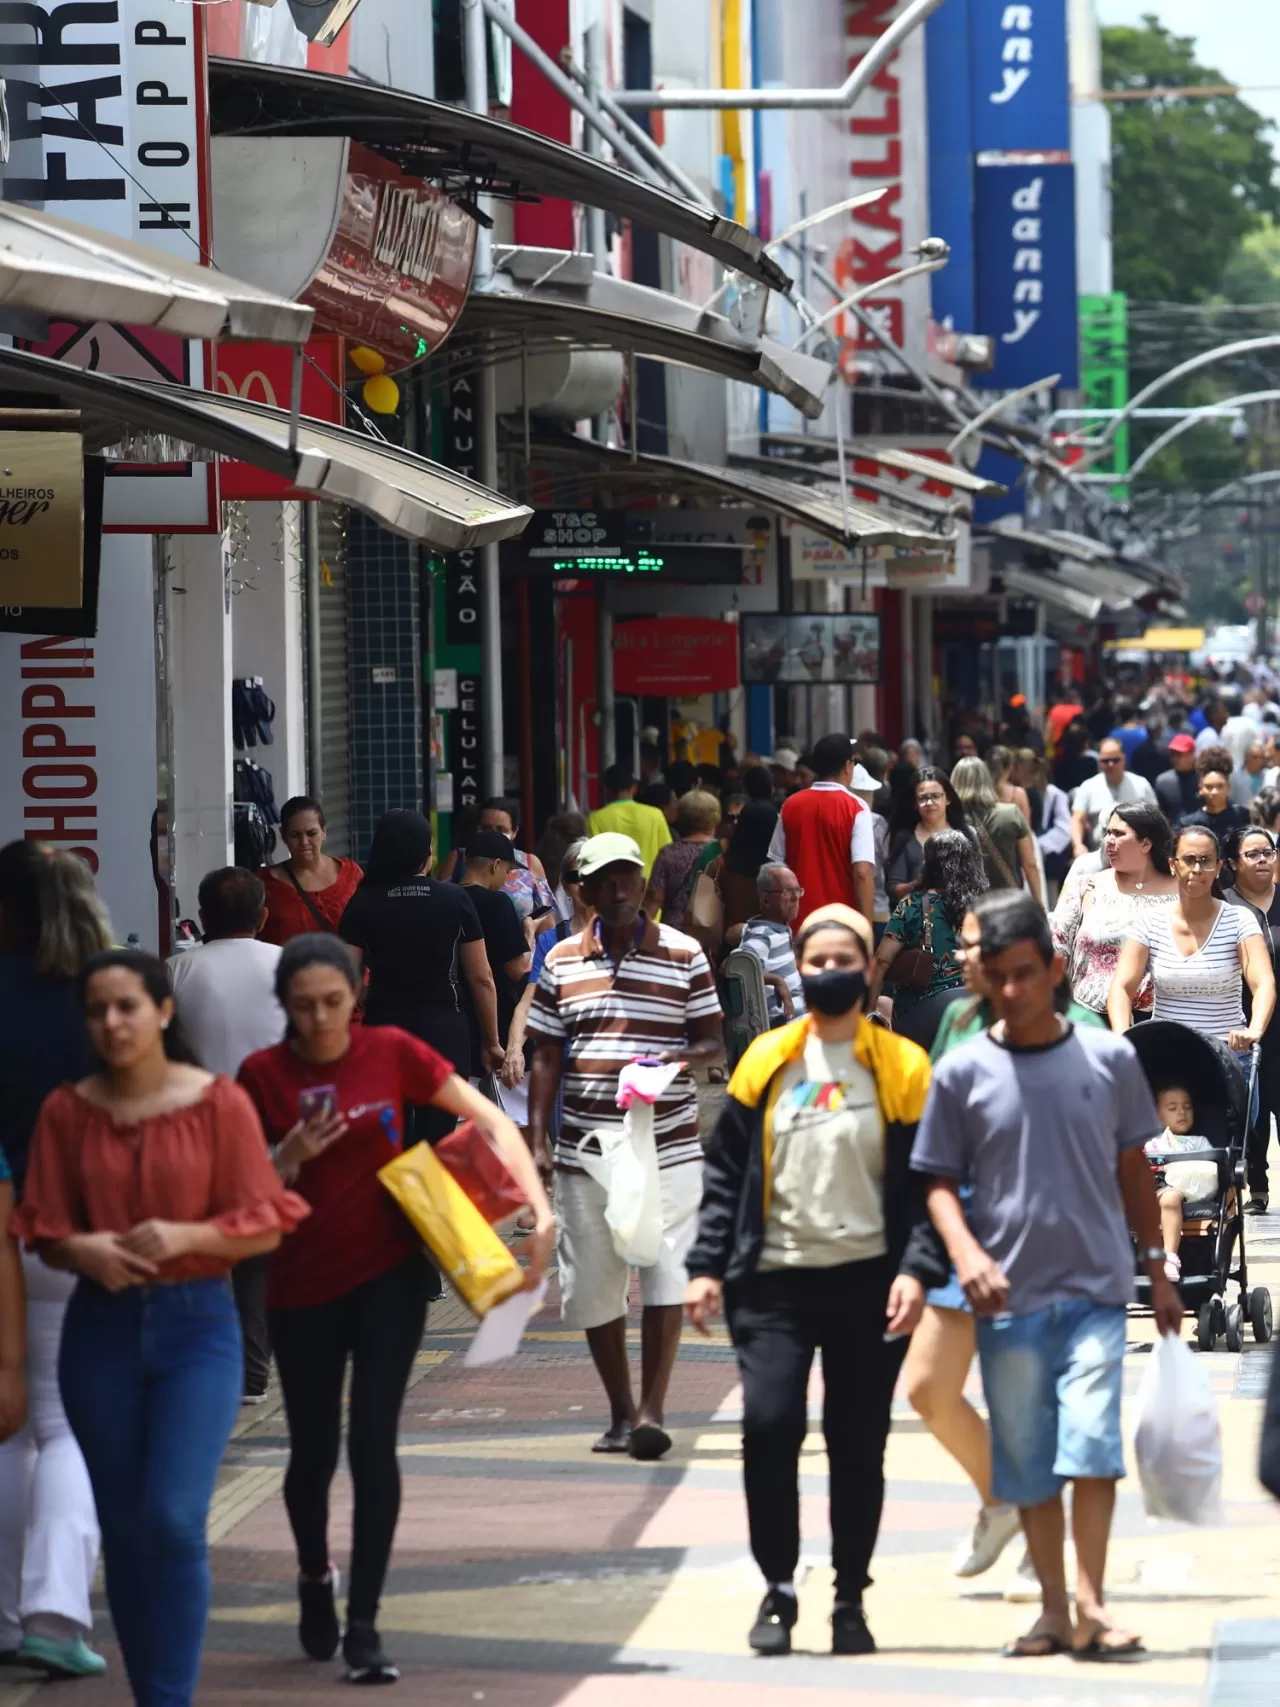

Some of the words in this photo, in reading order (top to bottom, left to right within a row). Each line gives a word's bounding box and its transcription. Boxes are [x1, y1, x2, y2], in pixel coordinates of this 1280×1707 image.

[1002, 177, 1043, 343] danny
[544, 528, 607, 544] SHOP
[459, 680, 477, 806] CELULAR
